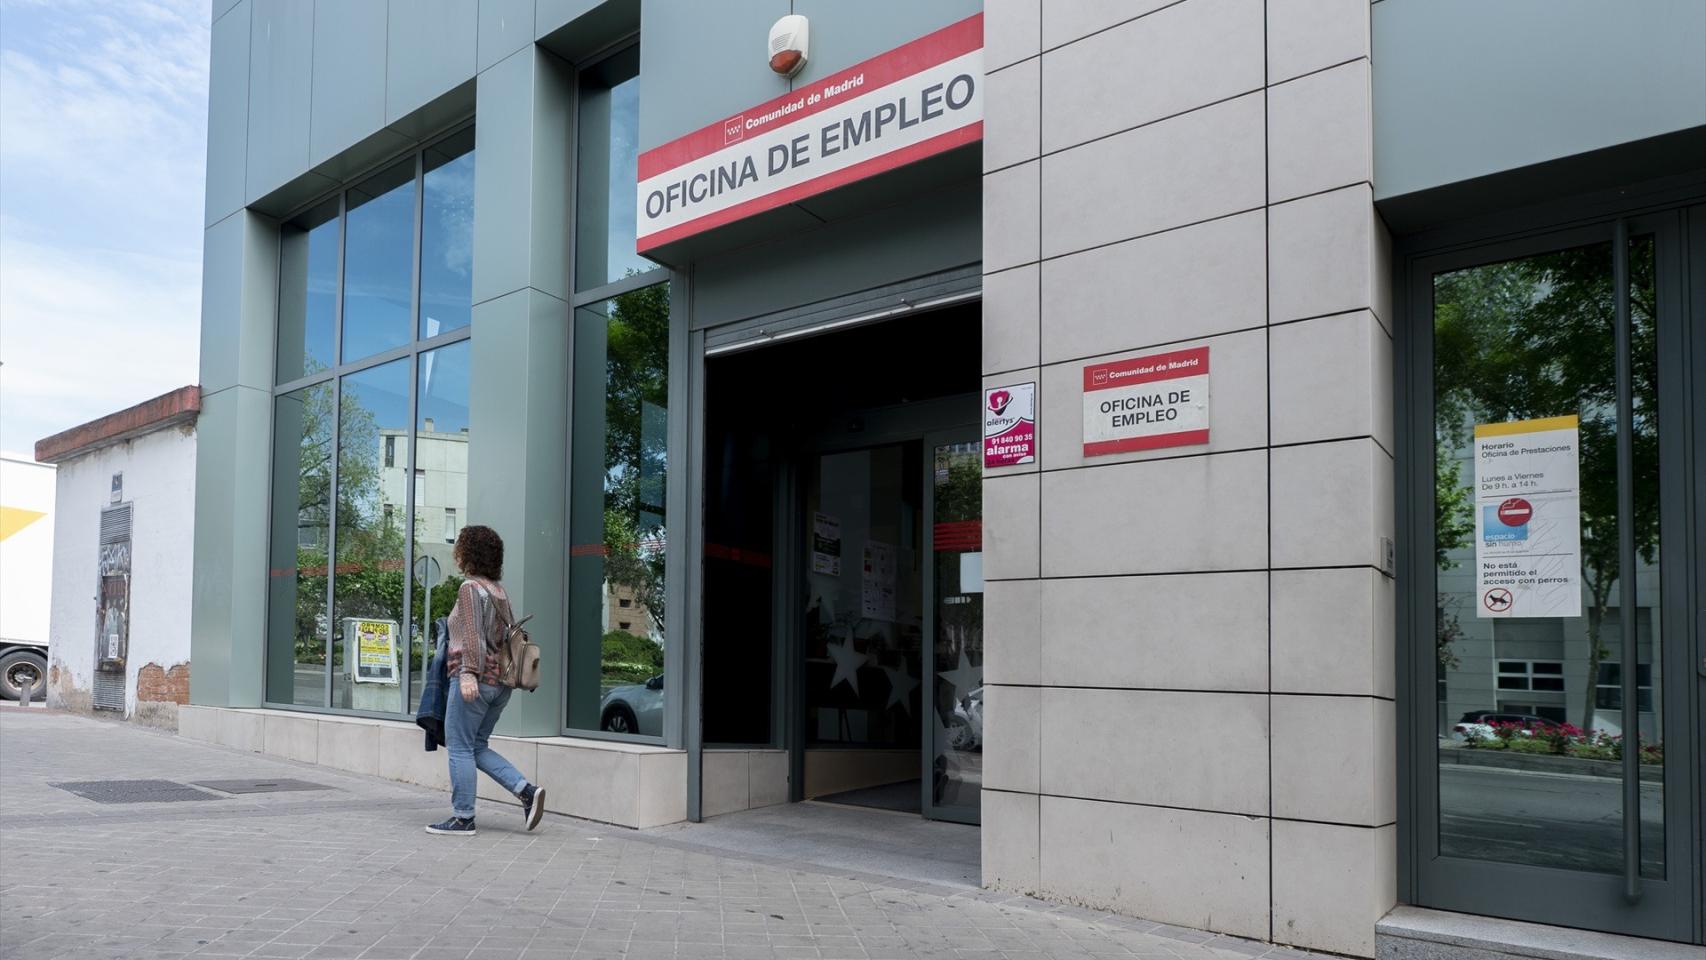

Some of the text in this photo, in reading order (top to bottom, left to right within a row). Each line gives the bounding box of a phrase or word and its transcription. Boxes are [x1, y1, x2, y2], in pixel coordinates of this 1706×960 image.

[745, 73, 864, 130] Comunidad de Madrid
[645, 73, 975, 219] OFICINA DE EMPLEO
[1109, 358, 1199, 378] Comunidad de Madrid
[1100, 390, 1191, 414] OFICINA DE
[1112, 408, 1178, 428] EMPLEO
[991, 433, 1033, 445] 91 840 90 35
[986, 444, 1028, 456] alarma
[1481, 442, 1515, 451] Horario
[1481, 450, 1508, 459] Oficina
[1520, 445, 1572, 455] Prestaciones
[1481, 475, 1506, 483] Lunes
[1514, 472, 1544, 480] Viernes
[1481, 483, 1494, 491] De
[1494, 482, 1500, 490] 9
[1485, 532, 1516, 540] espacio
[1485, 540, 1497, 548] sin
[1483, 561, 1518, 570] No está
[1483, 569, 1527, 578] permitido
[1537, 577, 1569, 585] perros
